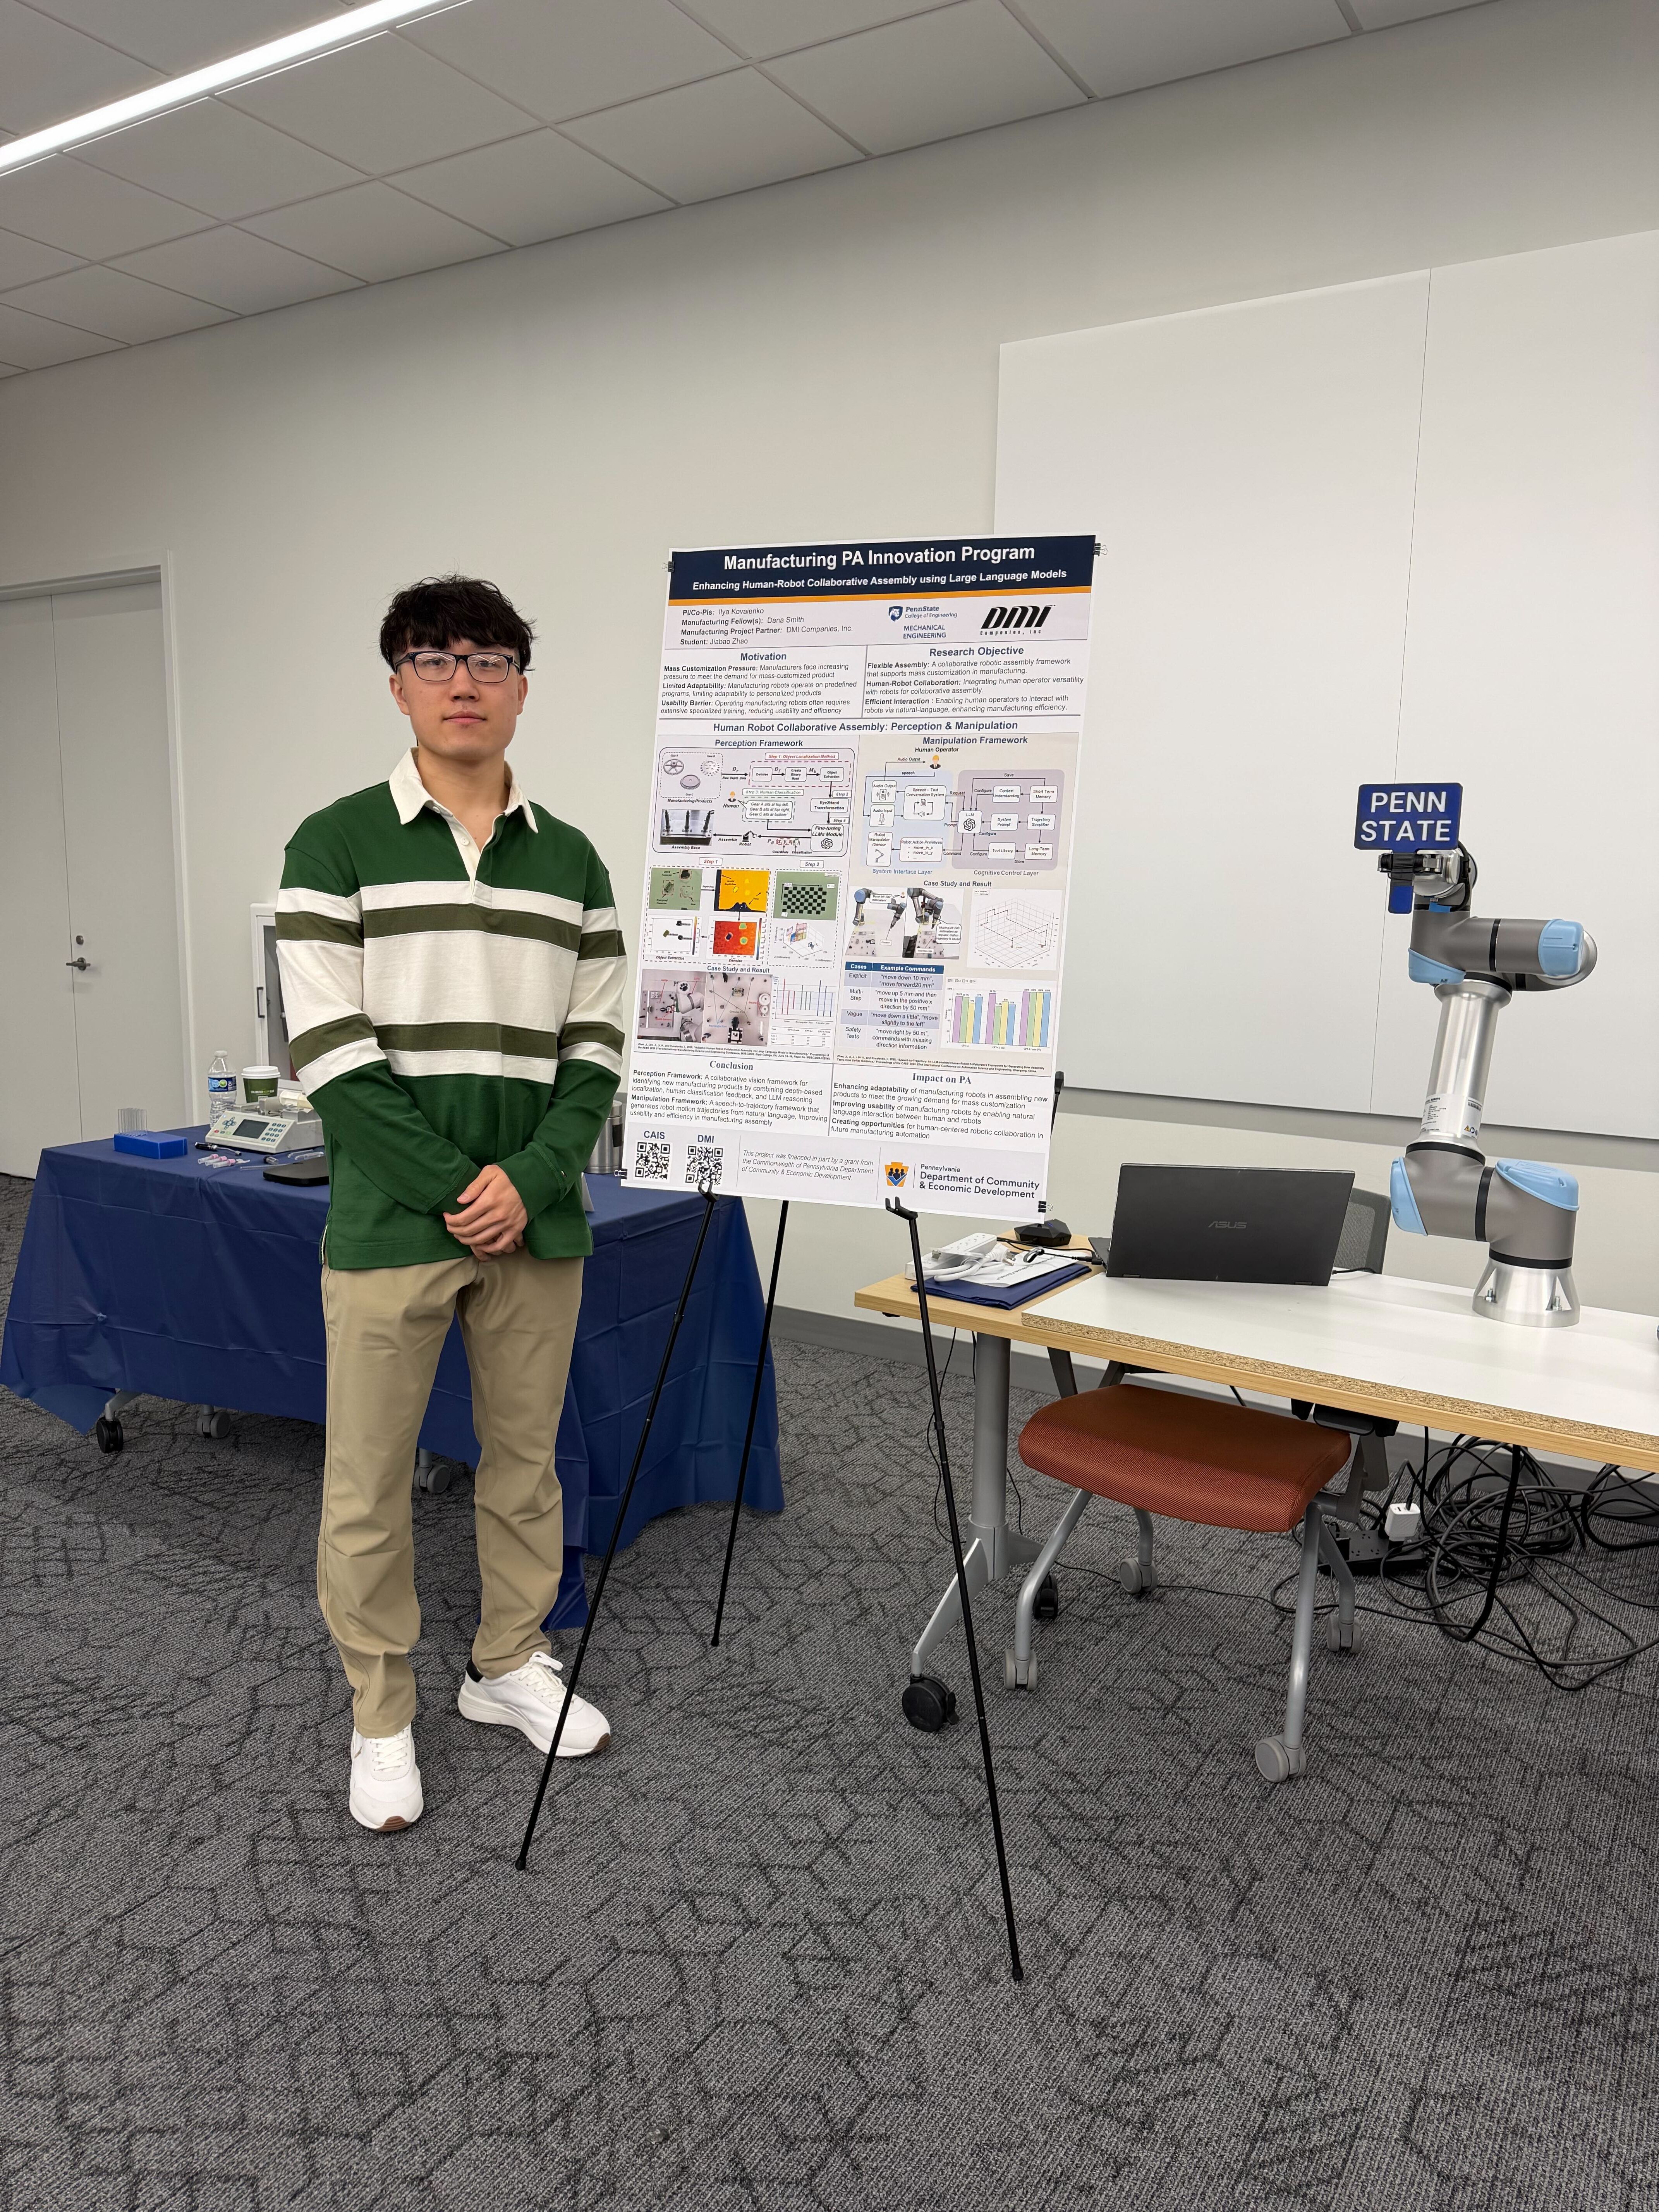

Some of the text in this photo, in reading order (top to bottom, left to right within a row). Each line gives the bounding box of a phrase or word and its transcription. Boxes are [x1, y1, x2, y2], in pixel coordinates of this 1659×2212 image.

[724, 546, 1035, 570] Manufacturing PA Innovation Program
[693, 569, 1067, 591] Enhancing Human-Robot Collaborative Assembly using Large Language Models
[731, 617, 763, 625] Fellow(s):
[801, 625, 839, 634] Companies,
[740, 652, 787, 661] Motivation
[929, 646, 1024, 657] Research Objective
[713, 721, 1018, 733] Human Robot Collaborative Assembly: Perception & Manipulation
[715, 739, 757, 748] Perception
[923, 736, 1028, 746] Manipulation Framework
[1371, 792, 1446, 812] PENN
[1360, 820, 1451, 841] STATE
[709, 1060, 753, 1070] Conclusion
[633, 1070, 665, 1078] Perception
[667, 1072, 703, 1080] Framework:
[913, 1073, 943, 1084] Impact
[959, 1076, 972, 1084] PA
[834, 1082, 869, 1092] Enhancing
[870, 1085, 909, 1094] adaptability
[919, 1089, 964, 1098] manufacturing
[644, 1130, 665, 1140] CAIS
[697, 1134, 714, 1144] DMI
[921, 1164, 960, 1172] Pennsylvania
[920, 1171, 1040, 1190] Department of Community
[919, 1181, 1036, 1199] & Economic Development
